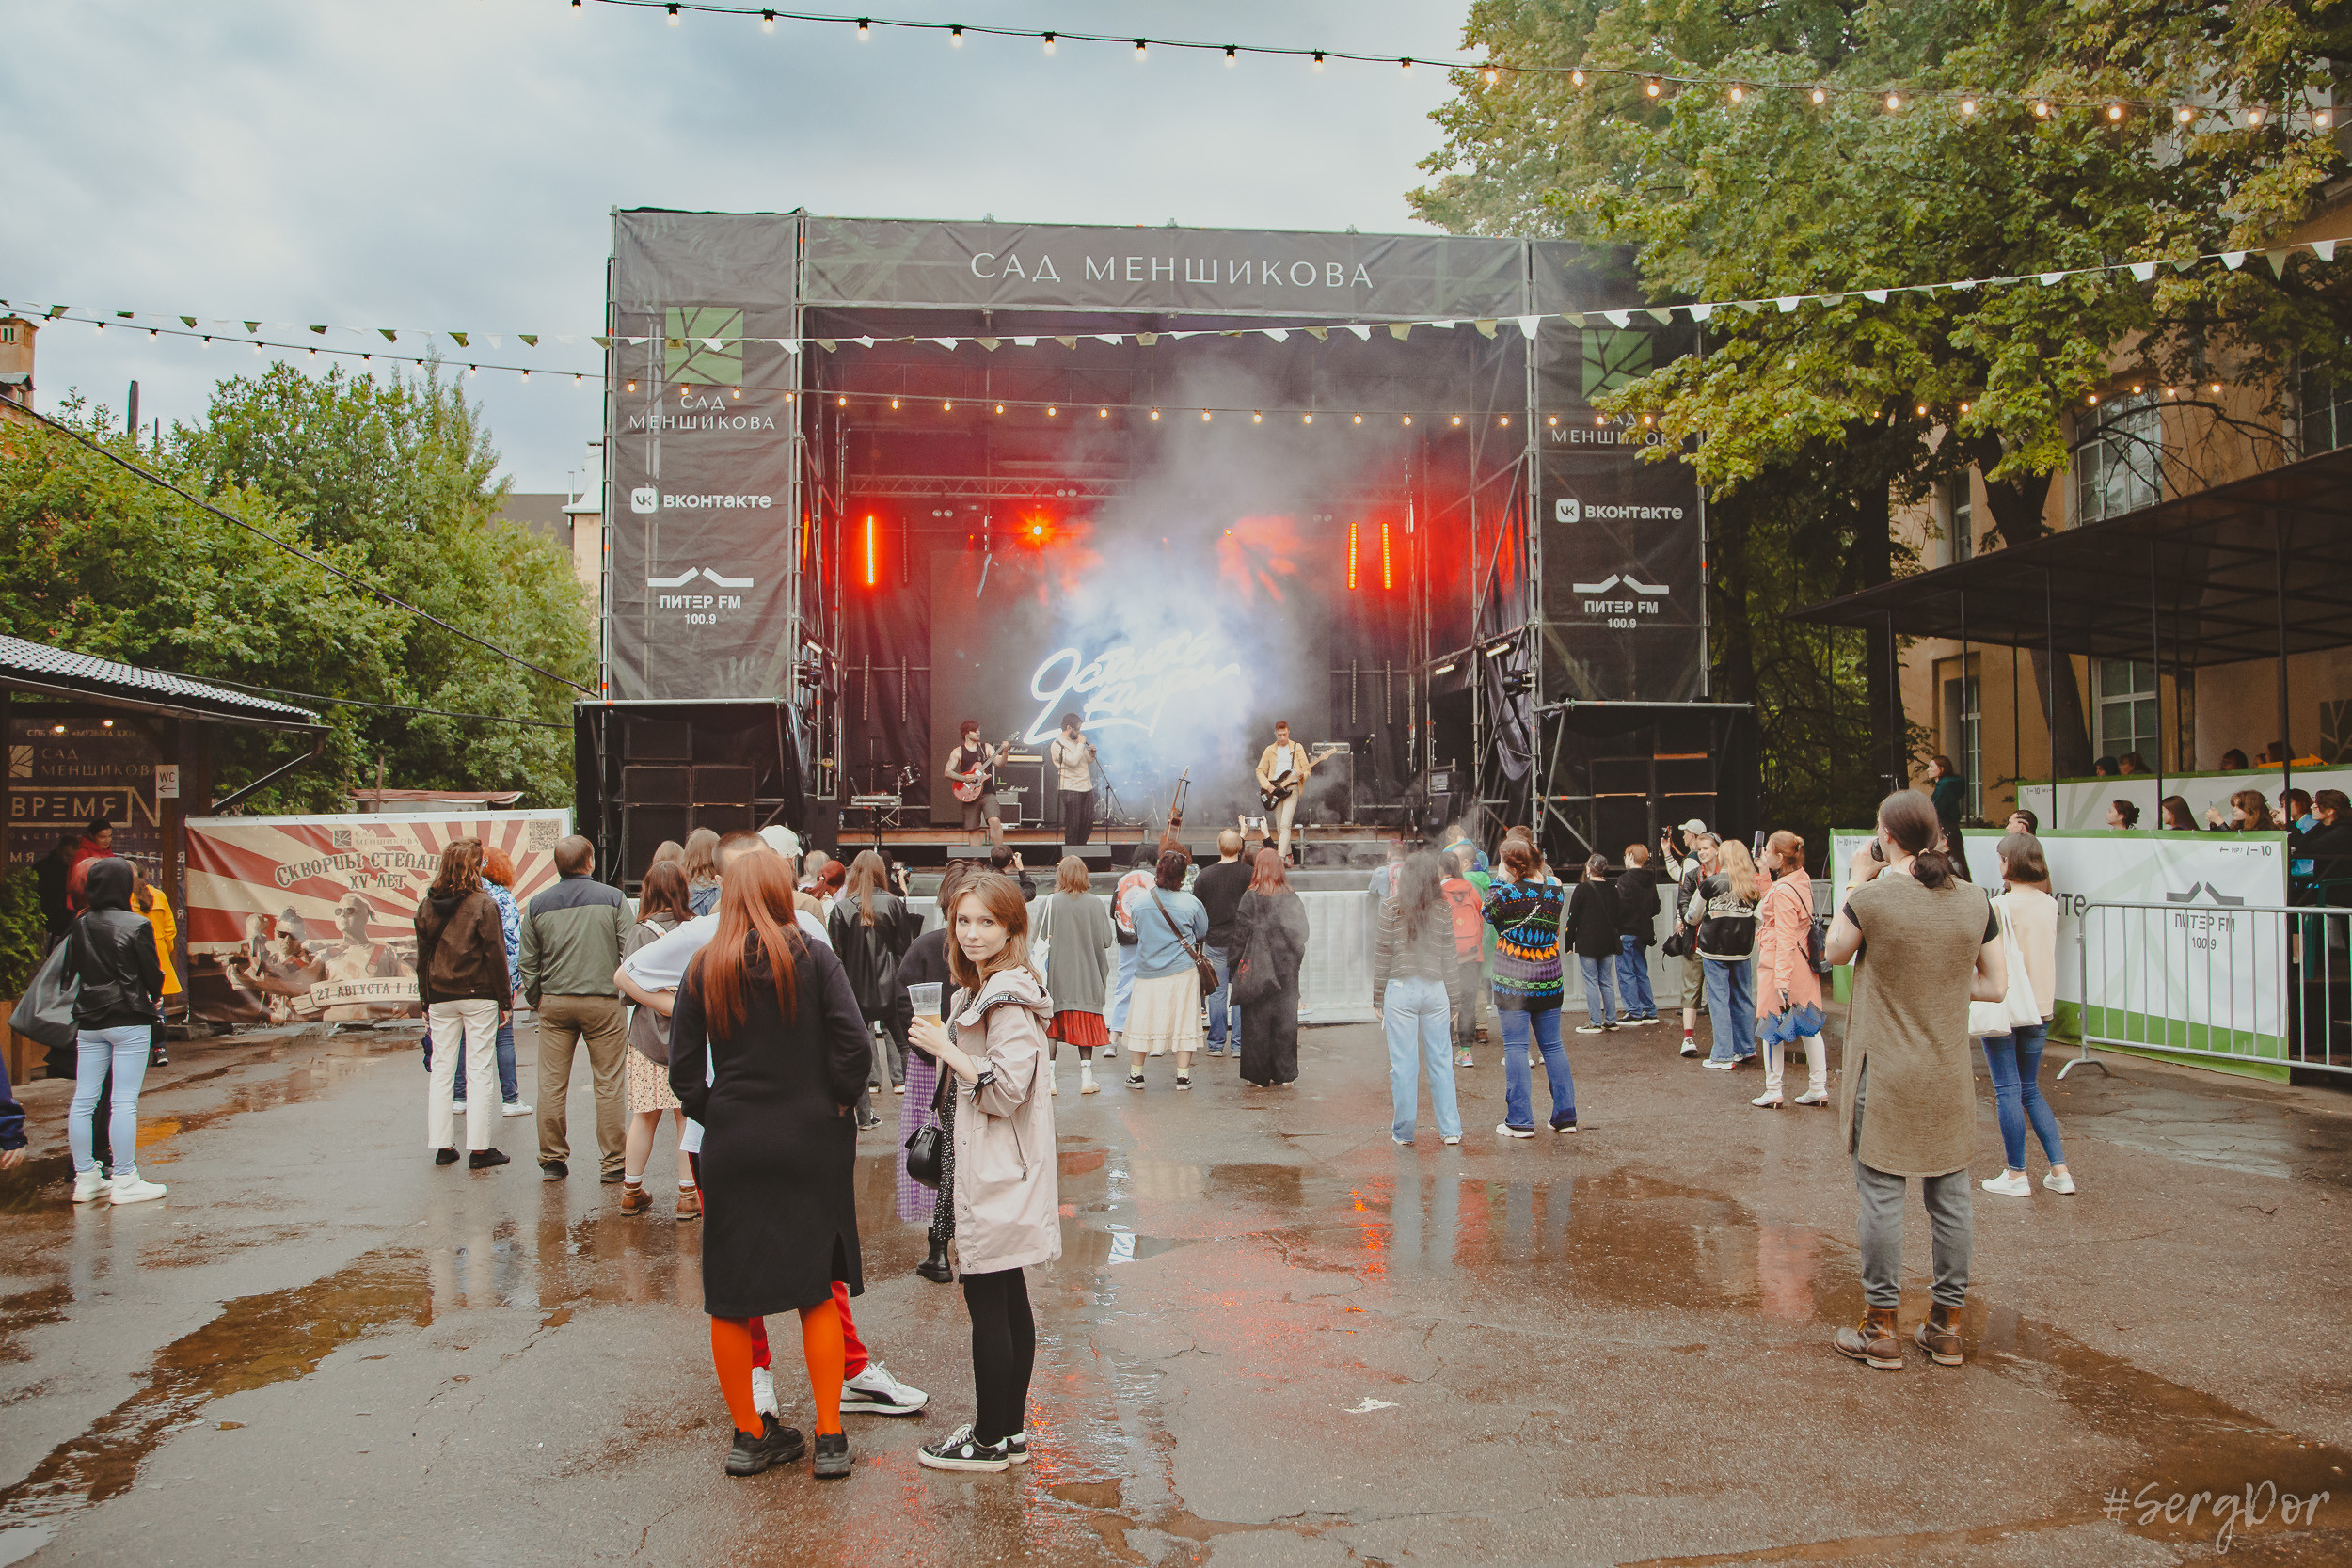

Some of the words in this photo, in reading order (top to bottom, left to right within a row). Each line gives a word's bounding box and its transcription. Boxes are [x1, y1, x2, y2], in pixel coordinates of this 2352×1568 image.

[970, 252, 1061, 283] САД
[1085, 255, 1374, 289] МЕНШИКОВА
[680, 395, 726, 411] САД
[629, 415, 775, 430] МЕНШИКОВА
[660, 594, 714, 609] ПИТЕР
[718, 595, 741, 610] FM
[1584, 600, 1633, 613] ПИТЕР
[1637, 601, 1659, 614] FM
[684, 613, 717, 625] 100.9
[1607, 617, 1637, 628] 100.9
[41, 748, 79, 760] САД
[160, 771, 176, 783] WC
[11, 796, 117, 817] ВРЕМЯ
[355, 830, 375, 838] САД
[355, 837, 420, 846] МЕНШИКОВА
[371, 851, 442, 872] СТЕПАН
[376, 874, 407, 889] ЛЕТ
[317, 987, 330, 1001] 27
[337, 982, 390, 998] АВГУСТА
